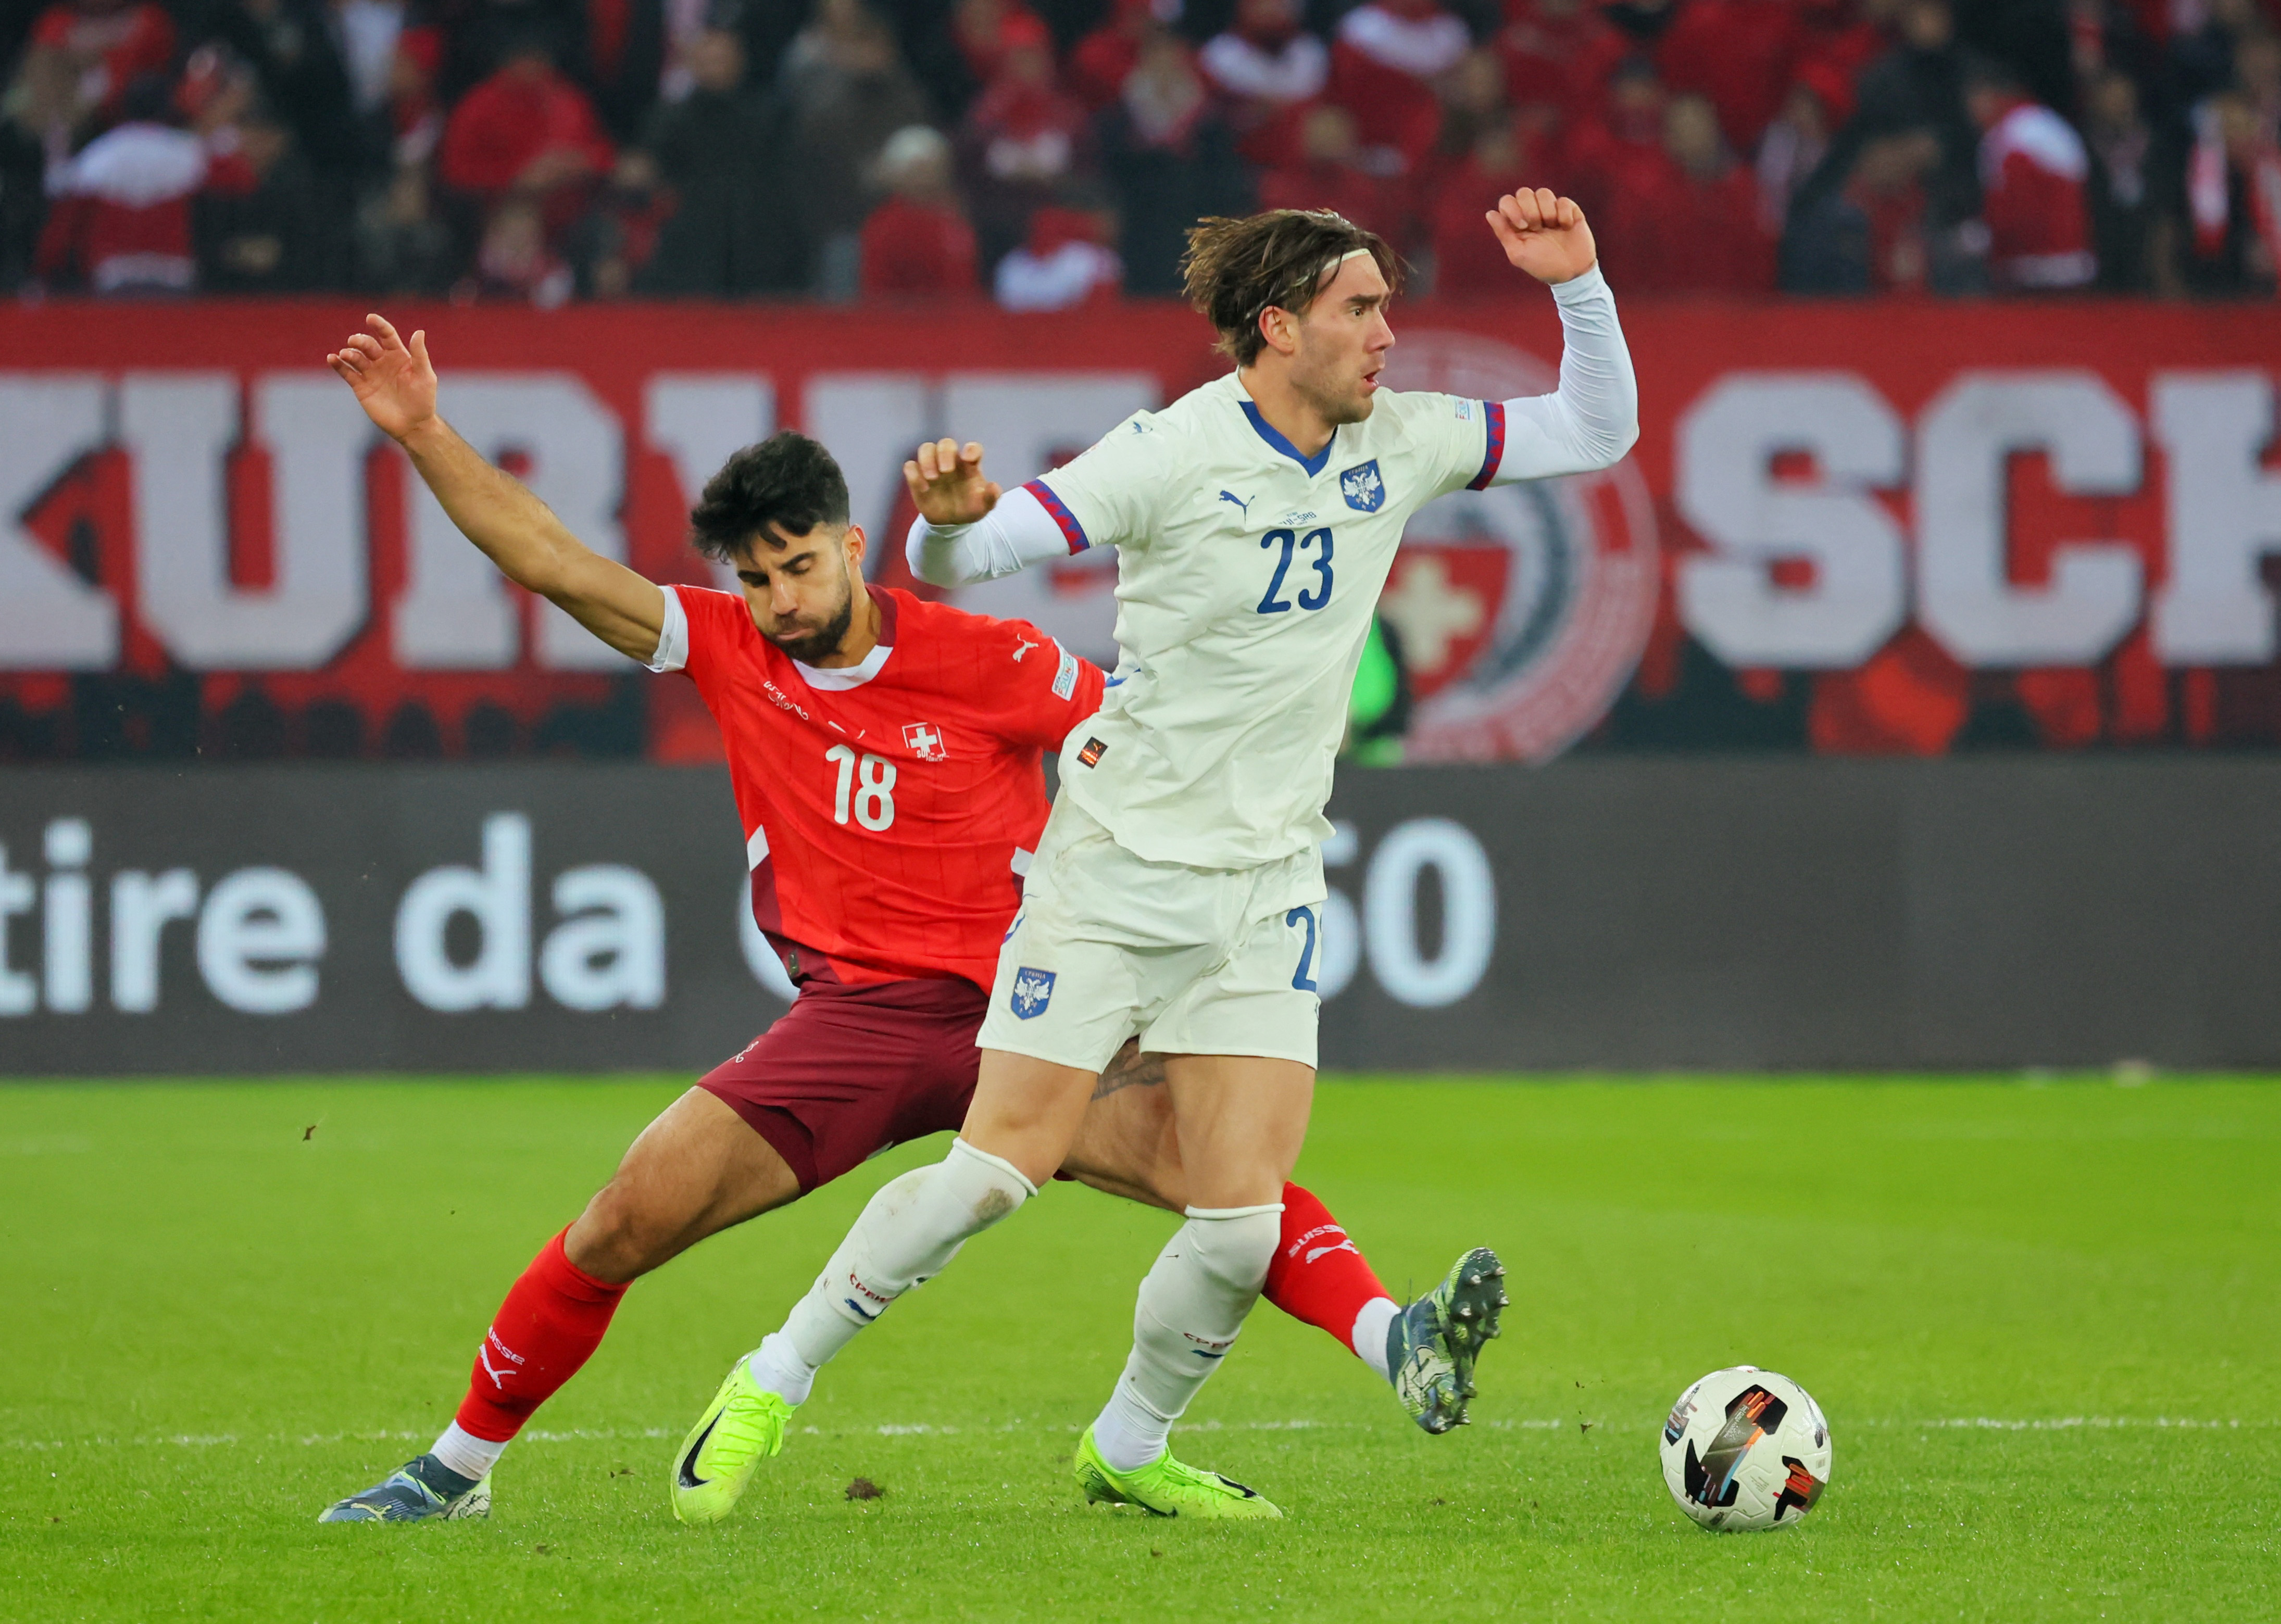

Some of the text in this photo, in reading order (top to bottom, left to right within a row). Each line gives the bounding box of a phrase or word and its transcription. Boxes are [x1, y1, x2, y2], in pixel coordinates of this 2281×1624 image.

[1257, 527, 1334, 614] 23
[825, 744, 897, 832] 18
[392, 809, 669, 1013] da
[1316, 815, 1497, 1009] 0
[1286, 905, 1322, 993] 2
